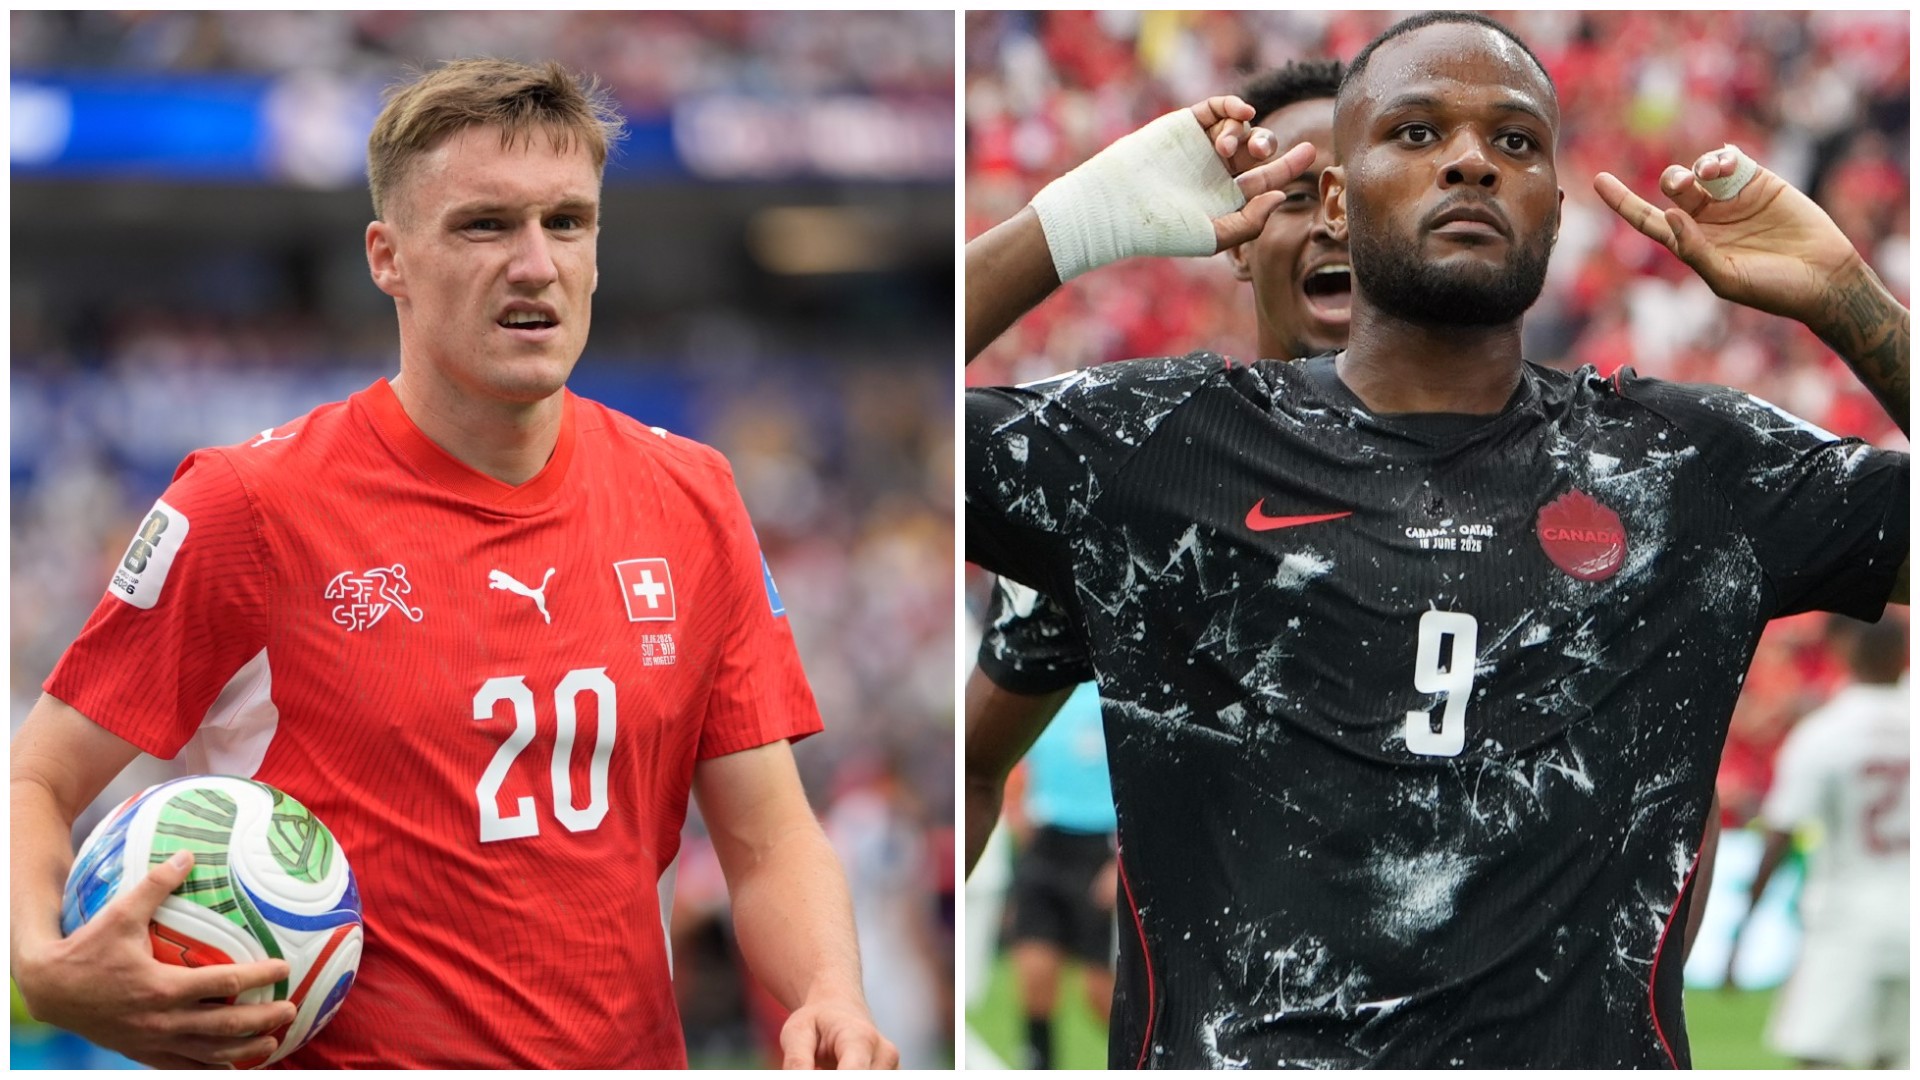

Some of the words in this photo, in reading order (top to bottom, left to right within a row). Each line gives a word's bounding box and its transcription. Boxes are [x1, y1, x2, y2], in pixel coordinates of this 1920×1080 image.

[1404, 527, 1448, 539] CANADA
[1459, 524, 1494, 537] QATAR
[1542, 528, 1620, 543] CANADA
[1433, 538, 1456, 550] JUNE
[1460, 539, 1482, 552] 2026
[113, 575, 136, 595] 2026
[641, 643, 654, 657] SUI
[660, 642, 676, 656] BIH
[1405, 610, 1478, 757] 9
[473, 667, 617, 843] 20
